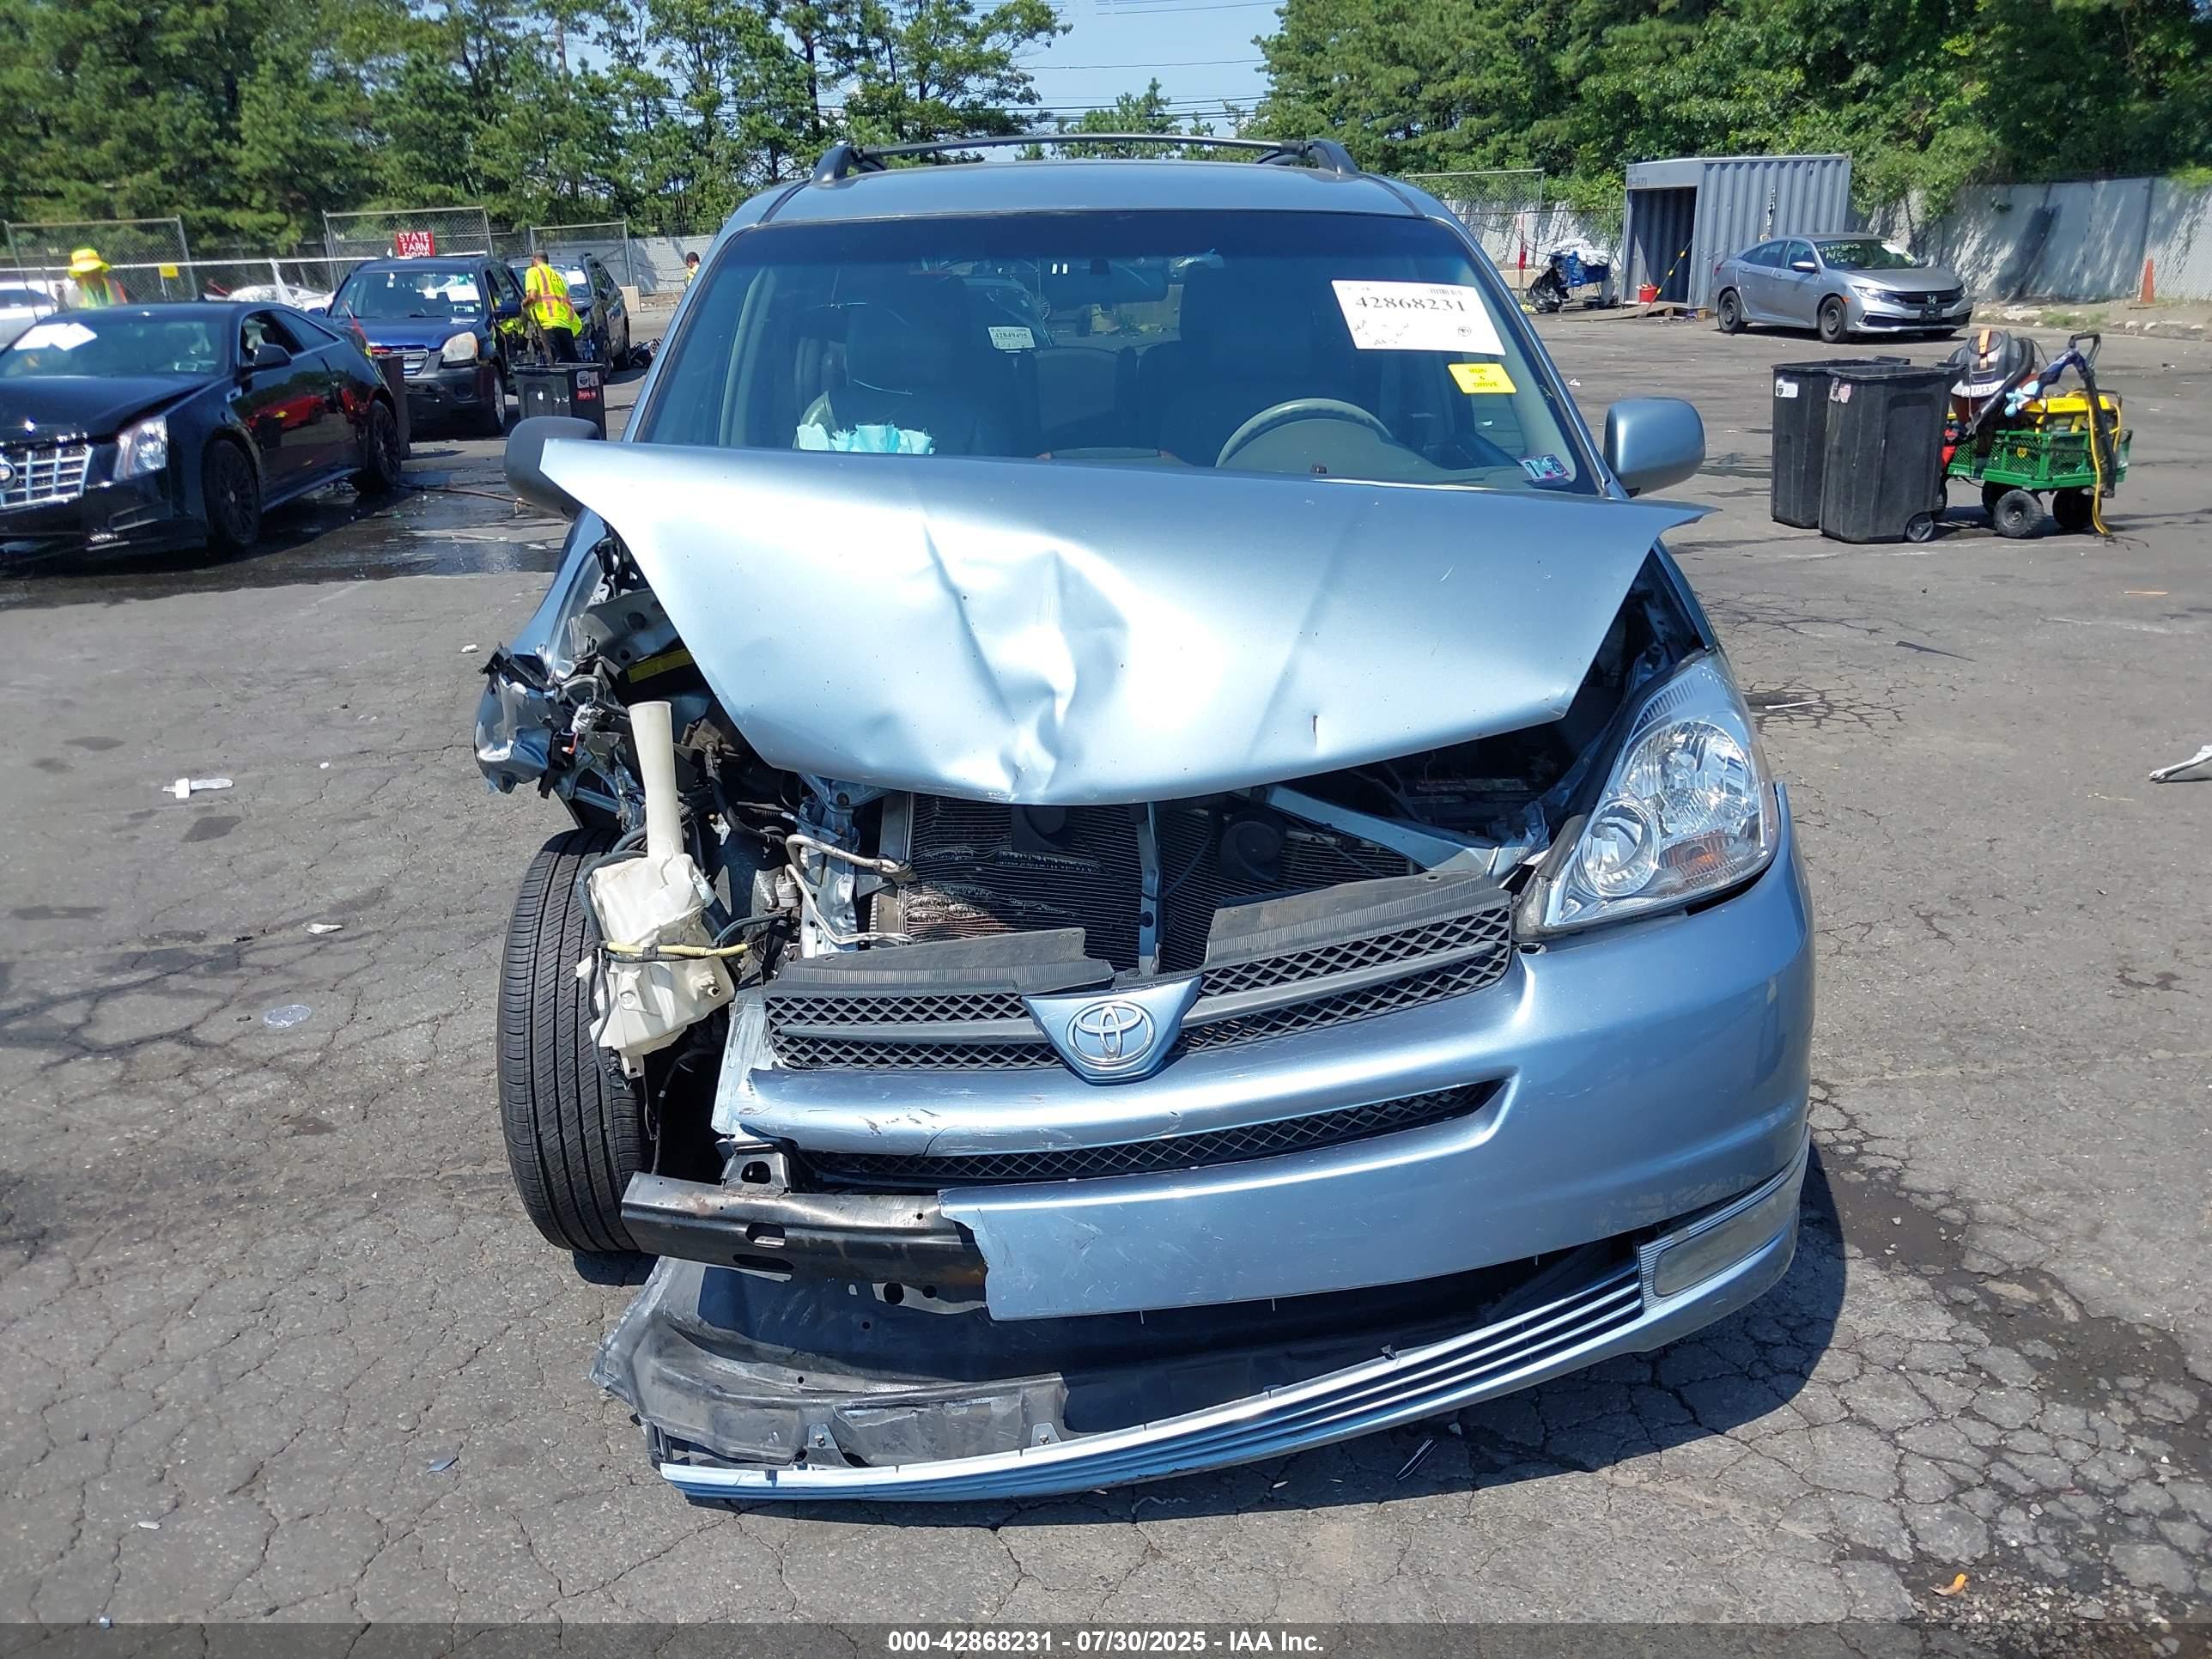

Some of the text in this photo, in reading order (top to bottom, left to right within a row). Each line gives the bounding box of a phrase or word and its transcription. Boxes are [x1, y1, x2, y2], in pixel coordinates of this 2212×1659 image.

[398, 232, 430, 242] STATE
[402, 242, 430, 252] FARM
[1355, 295, 1466, 313] 42868231
